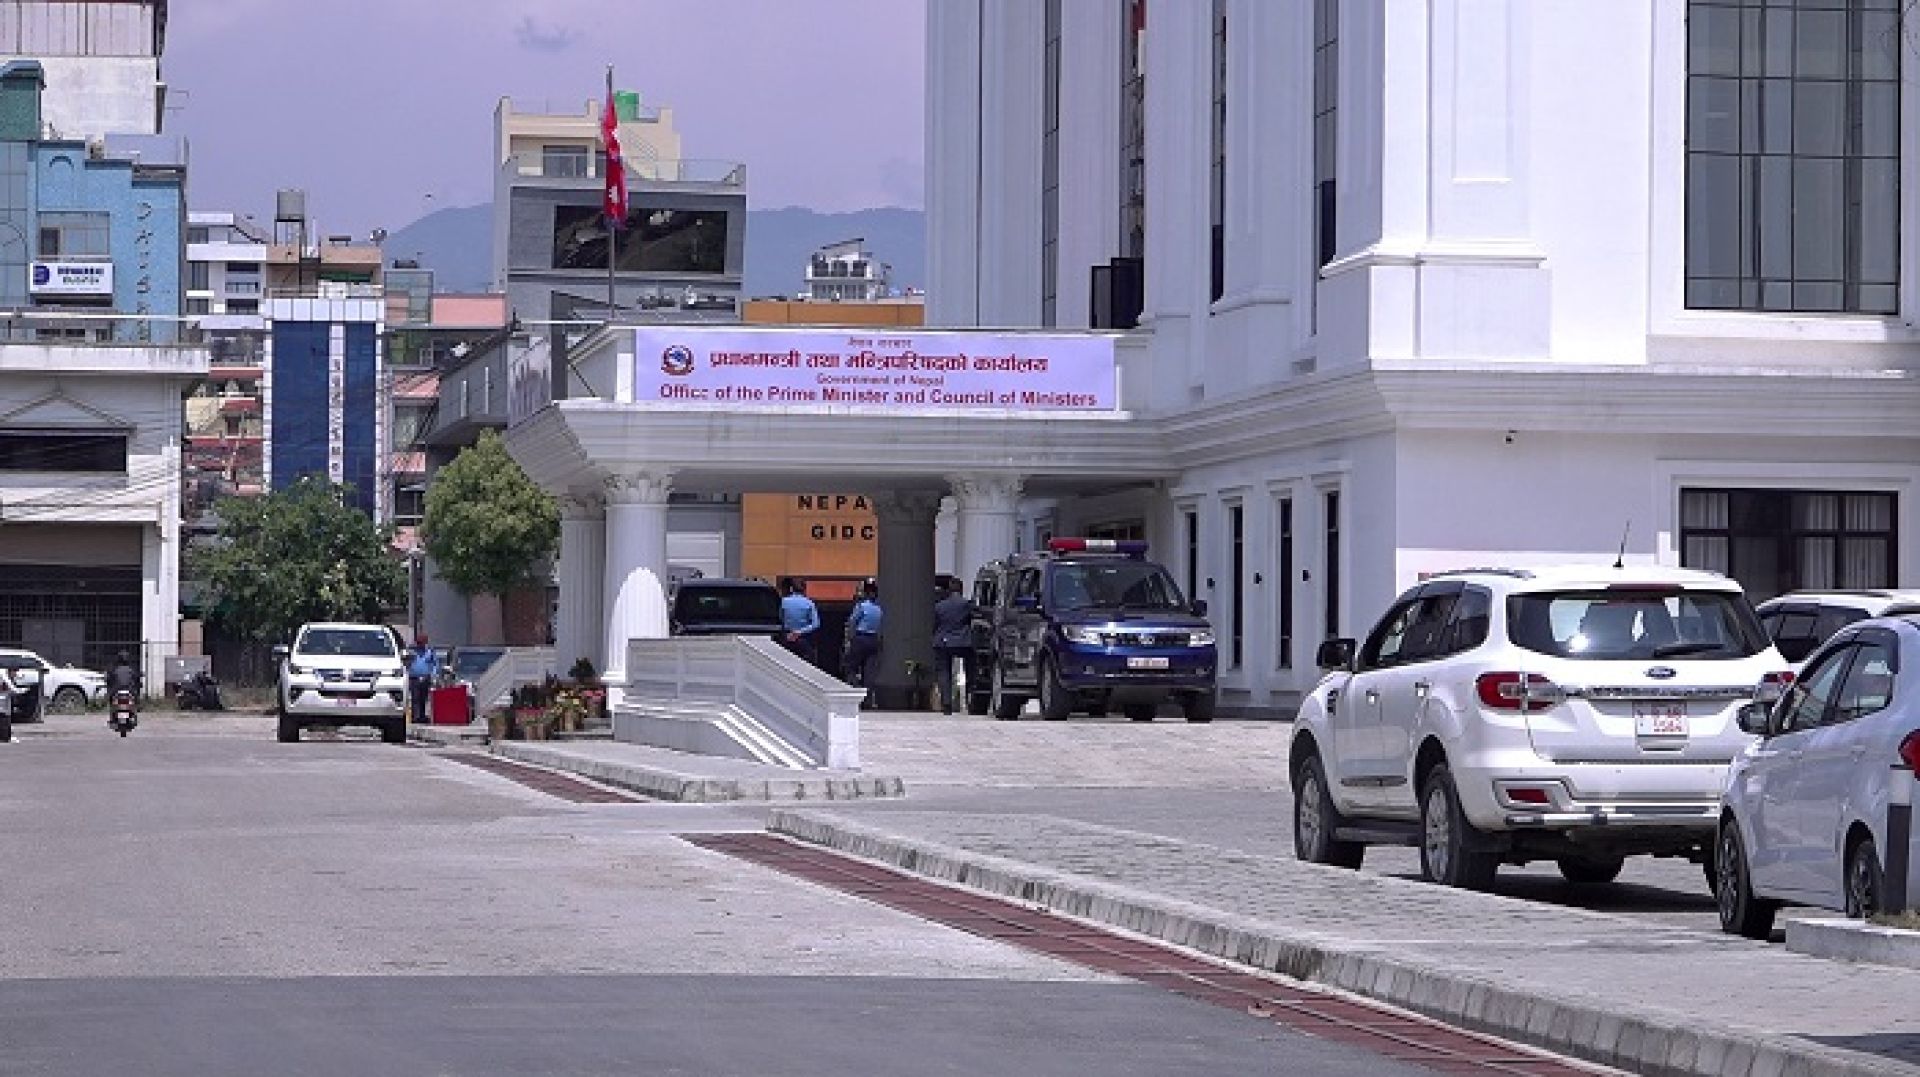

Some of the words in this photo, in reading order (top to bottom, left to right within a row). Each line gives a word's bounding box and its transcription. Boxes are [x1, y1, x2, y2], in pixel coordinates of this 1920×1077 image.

[806, 353, 840, 367] तथा
[973, 354, 1048, 372] कार्यालय
[817, 373, 889, 384] Government
[894, 375, 906, 385] of
[911, 376, 944, 387] Nepal
[660, 383, 708, 399] Office
[715, 385, 731, 400] of
[737, 386, 763, 400] the
[768, 386, 817, 401] Prime
[823, 387, 889, 403] Minister
[894, 390, 925, 404] and
[930, 389, 994, 404] Council
[1000, 390, 1016, 405] of
[1021, 391, 1098, 407] Ministers
[798, 495, 868, 511] NEPA
[811, 525, 875, 541] GIDC
